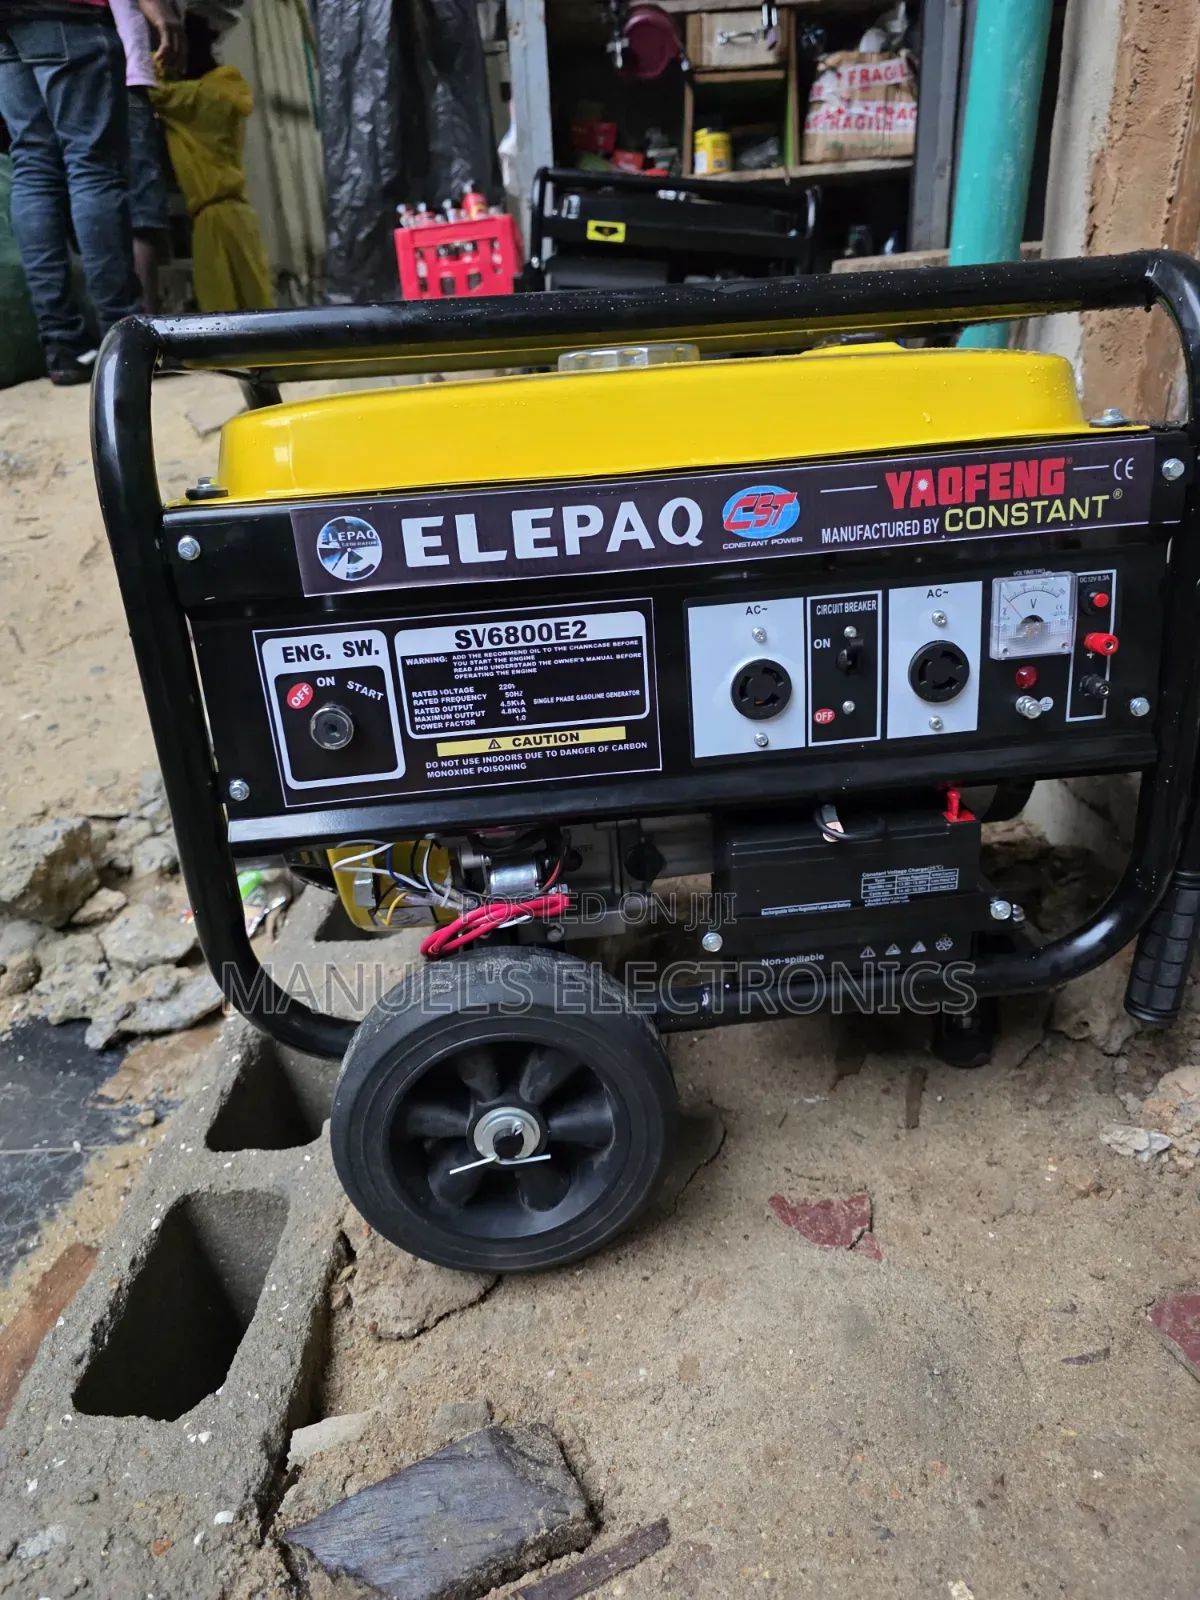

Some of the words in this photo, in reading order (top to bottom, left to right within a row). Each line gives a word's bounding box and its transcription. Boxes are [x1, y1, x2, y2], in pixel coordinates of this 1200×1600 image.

[1113, 457, 1134, 480] CE
[722, 491, 798, 530] CST
[944, 494, 1110, 533] CONSTANT
[321, 529, 377, 543] ELEPAQ
[400, 497, 704, 568] ELEPAQ
[820, 519, 921, 545] MANUFACTURED
[923, 517, 940, 535] BY
[722, 540, 769, 550] CONSTANT
[771, 536, 803, 545] POWER
[816, 602, 844, 616] CIRCUIT
[844, 599, 877, 614] BREAKER
[1030, 598, 1038, 609] V
[454, 619, 588, 650] SV6800E2
[281, 643, 331, 664] ENG.
[342, 639, 380, 658] SW.
[813, 638, 831, 649] ON
[405, 655, 448, 666] WARNING:
[483, 649, 528, 658] RECOMMEND
[490, 661, 537, 670] UNDERSTAND
[586, 654, 614, 662] MANUAL
[615, 652, 642, 660] BEFORE
[316, 676, 336, 687] ON
[454, 672, 494, 680] OPERATING
[291, 684, 311, 707] OFF
[346, 680, 384, 701] START
[412, 689, 438, 698] RATED
[413, 698, 439, 707] RATED
[441, 693, 488, 704] FREQUENCY
[504, 690, 523, 698] 50HZ
[533, 696, 555, 705] SINGLE
[555, 695, 575, 703] PHASE
[576, 692, 605, 701] GASOLINE
[605, 689, 640, 699] GENERATOR
[414, 707, 440, 716] RATED
[442, 703, 474, 713] OUTPUT
[414, 714, 453, 723] MAXIMUM
[454, 710, 486, 719] OUTPUT
[815, 711, 833, 722] OFF
[416, 722, 444, 731] POWER
[445, 719, 476, 728] FACTOR
[512, 731, 580, 747] CAUTION
[425, 761, 439, 769] DO
[441, 759, 460, 767] NOT
[462, 757, 480, 765] USE
[482, 753, 523, 764] INDOORS
[525, 751, 543, 760] DUE
[545, 750, 558, 758] TO
[560, 746, 596, 756] DANGER
[598, 745, 609, 753] OF
[611, 741, 648, 752] CARBON
[426, 767, 475, 779] MONOXIDE
[477, 762, 527, 774] POISONING
[761, 953, 825, 967] Non-spillable
